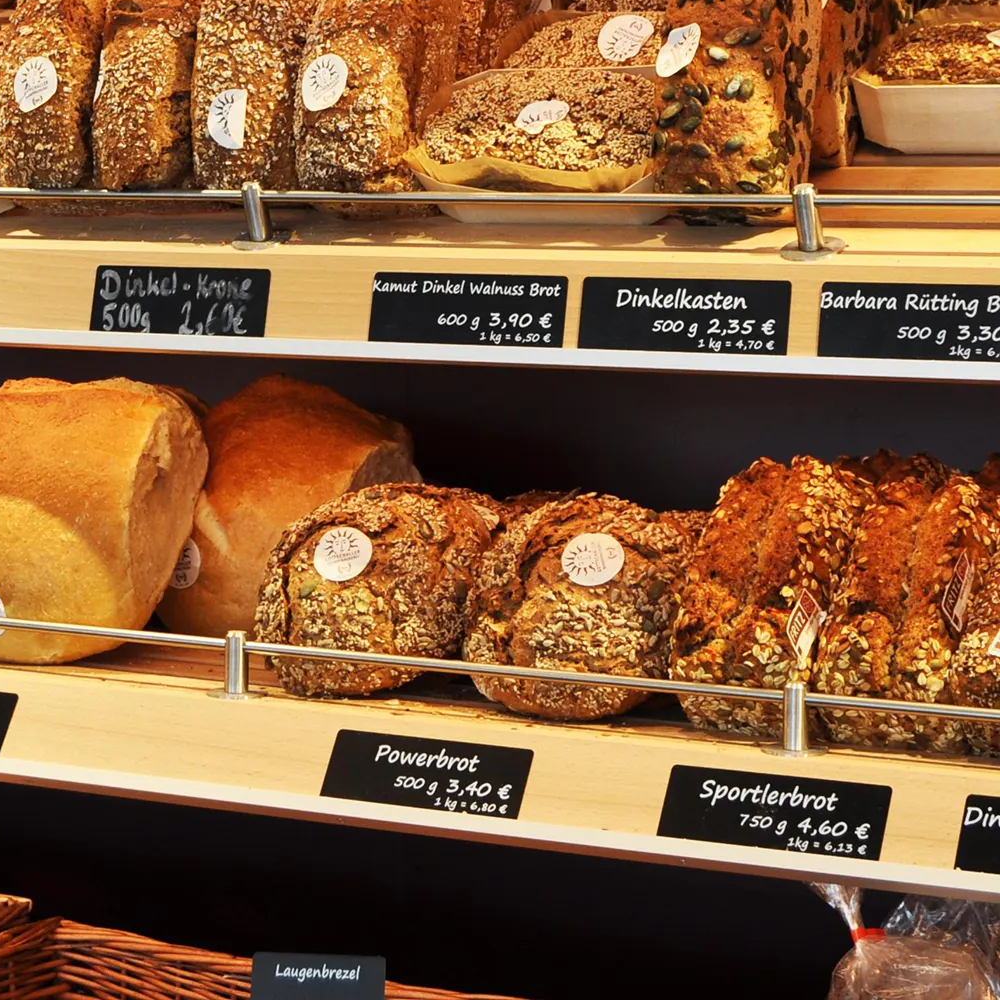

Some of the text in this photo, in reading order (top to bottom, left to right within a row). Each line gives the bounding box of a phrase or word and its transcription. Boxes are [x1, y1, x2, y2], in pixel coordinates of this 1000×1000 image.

[373, 279, 561, 297] Kamut Dinkel Walnuss Brot
[616, 287, 748, 310] Dinkelkasten
[820, 290, 897, 310] Barbara
[905, 293, 979, 318] Rütting
[437, 312, 552, 330] 600 g 3,90 €
[652, 318, 776, 337] 500 g 2,35 €
[480, 330, 540, 344] 1 kg 6,50
[698, 338, 762, 352] 1 kg 4,70
[897, 327, 931, 339] 500
[936, 329, 947, 345] g
[375, 744, 480, 772] Powerbrot
[394, 775, 512, 800] 500 g 3,40 €
[699, 779, 838, 811] Sportlerbrot
[434, 797, 496, 813] 1 kg 6,80
[739, 814, 871, 839] 750 g 4,60 €
[824, 841, 853, 853] 6,13
[275, 964, 361, 982] Laugenbrezel
